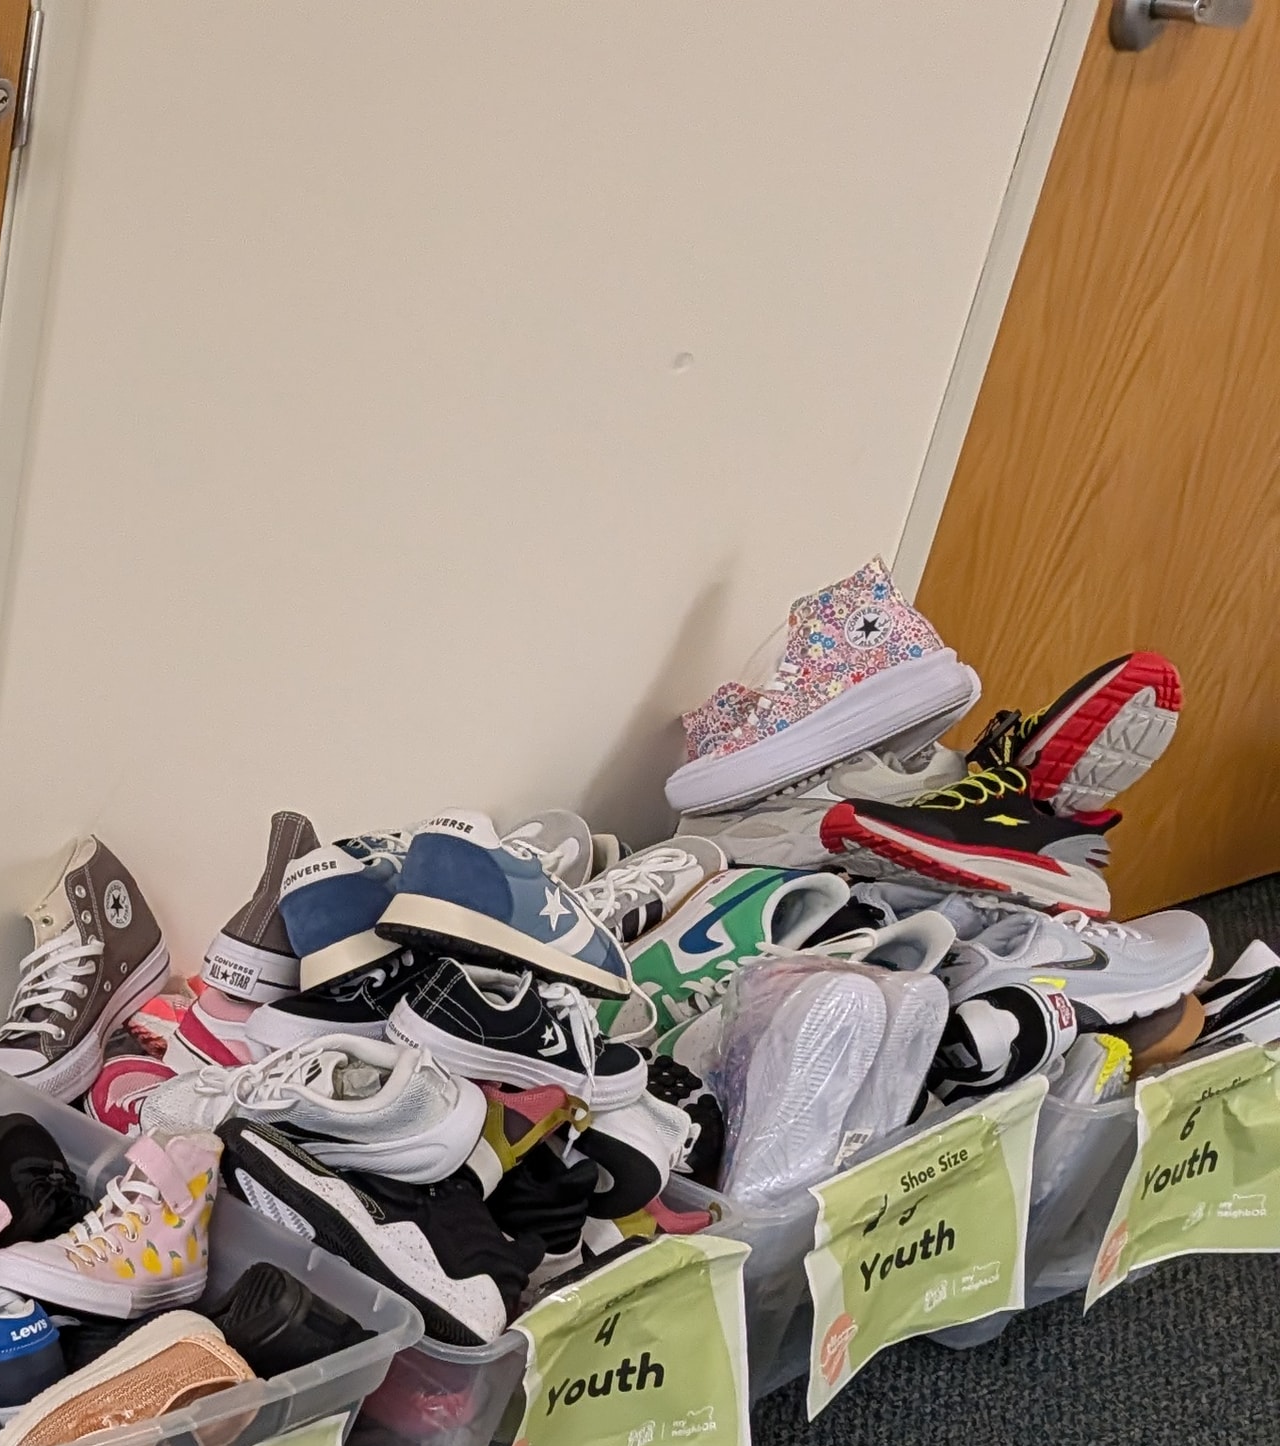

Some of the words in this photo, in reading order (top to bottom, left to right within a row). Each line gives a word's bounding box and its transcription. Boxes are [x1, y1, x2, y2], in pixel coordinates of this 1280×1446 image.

[209, 963, 222, 980] ALL
[229, 971, 251, 990] STAR
[213, 955, 255, 976] CONVERSE
[1179, 1106, 1202, 1142] 6
[900, 1171, 936, 1193] Shoe
[938, 1149, 968, 1172] Size
[1141, 1141, 1218, 1200] Youth
[860, 1220, 955, 1292] Youth
[594, 1312, 621, 1347] 4
[546, 1352, 665, 1416] Youth
